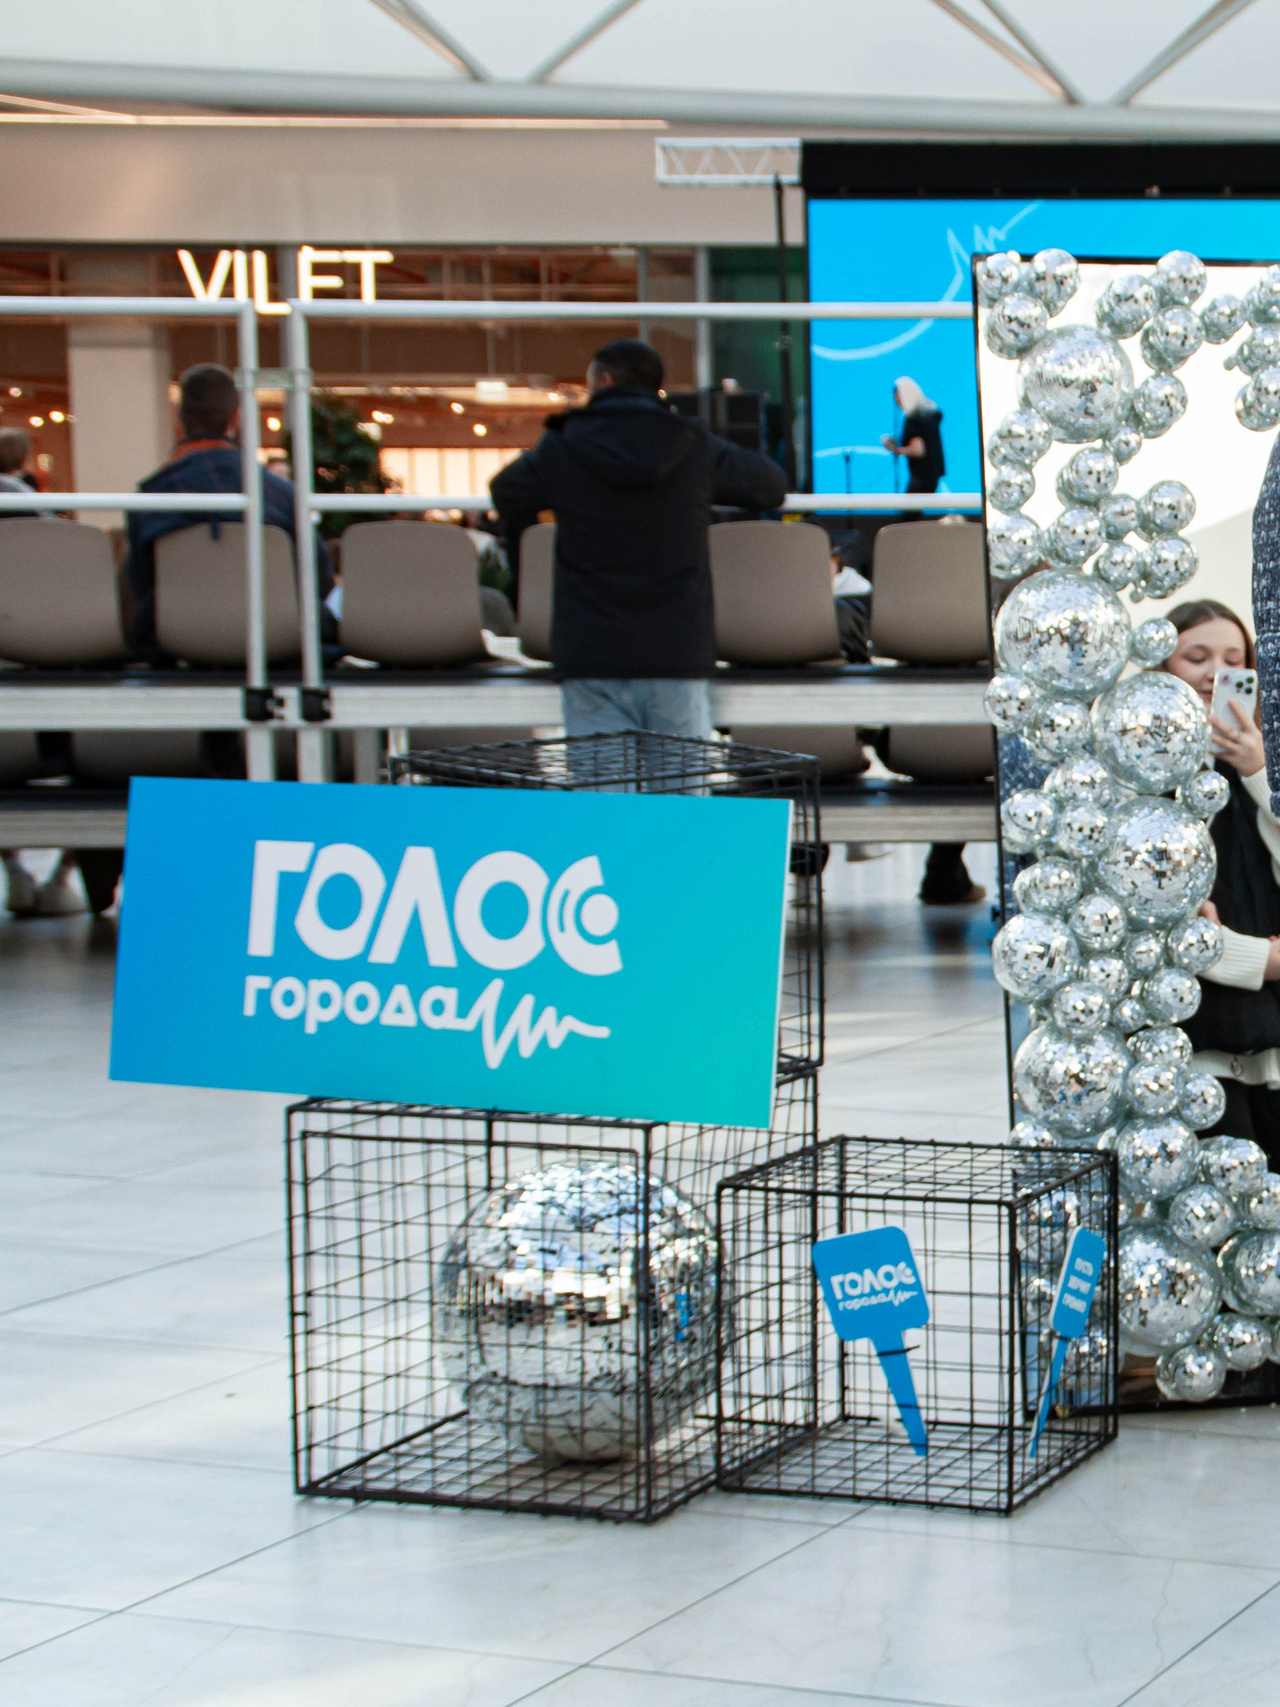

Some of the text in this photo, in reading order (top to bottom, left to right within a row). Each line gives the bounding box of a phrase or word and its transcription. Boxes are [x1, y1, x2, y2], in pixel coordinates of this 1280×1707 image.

[247, 839, 623, 976] ГОЛОС
[242, 974, 478, 1035] города
[830, 1261, 917, 1301] ГОЛОС
